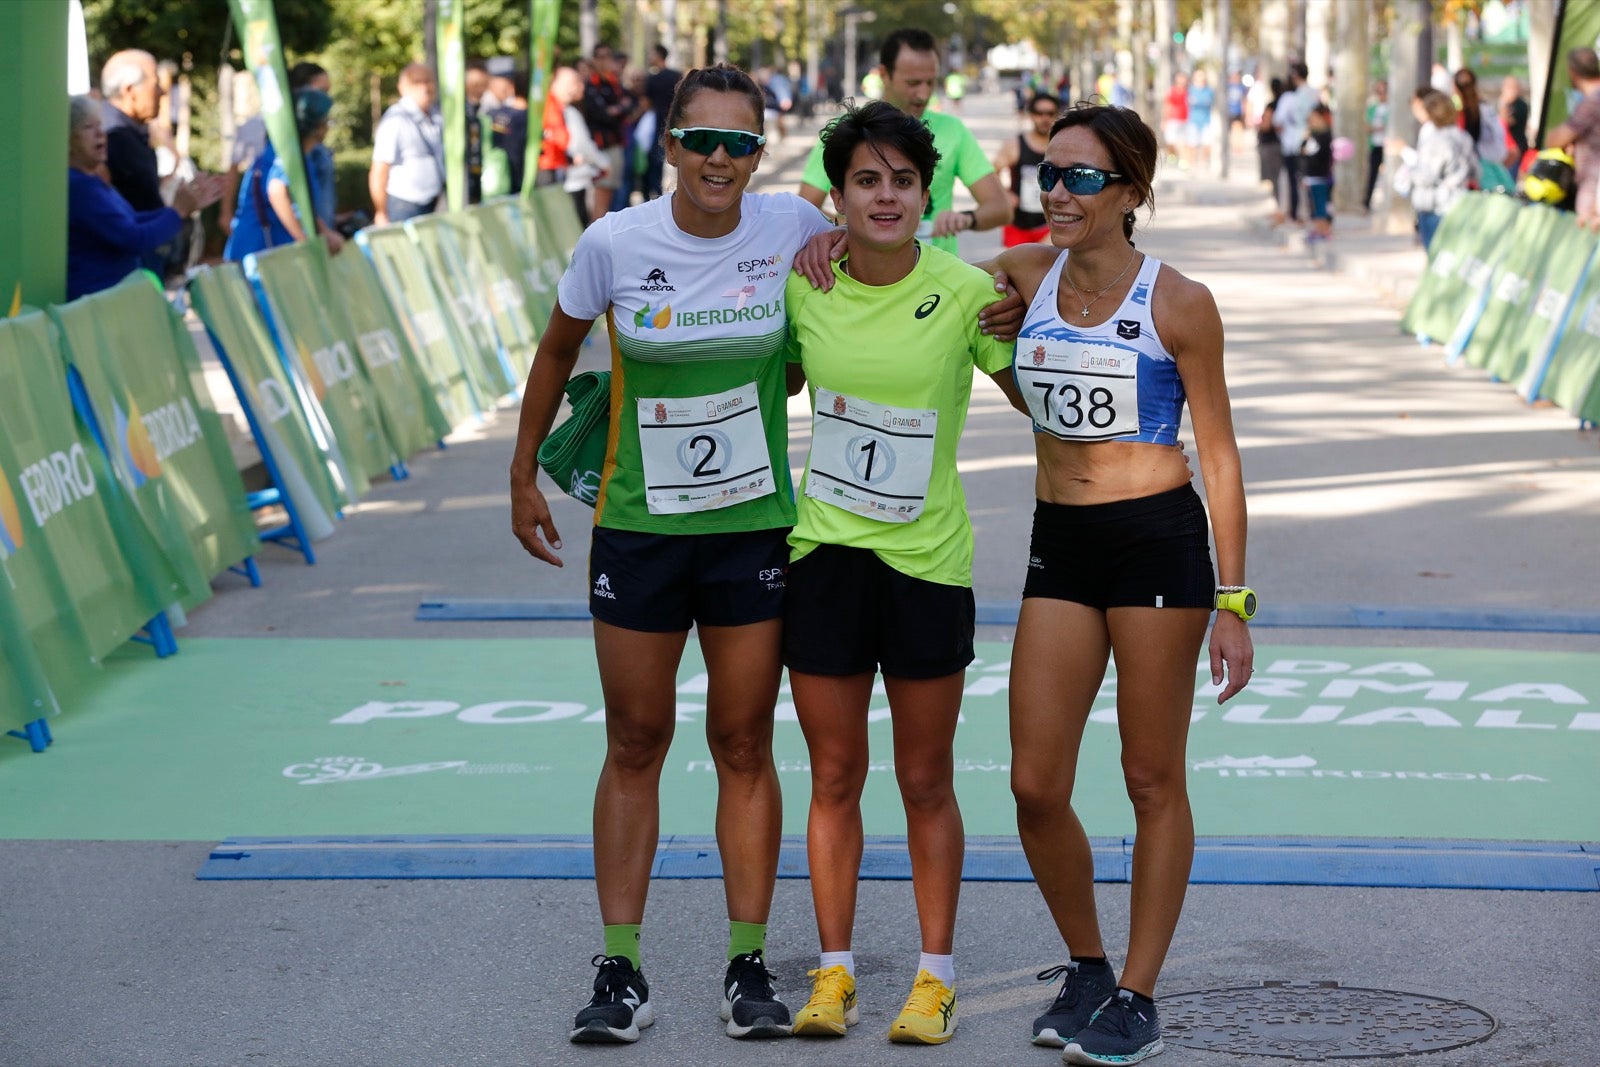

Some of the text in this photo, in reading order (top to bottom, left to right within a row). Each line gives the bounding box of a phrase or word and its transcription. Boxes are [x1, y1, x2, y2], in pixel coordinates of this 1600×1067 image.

[737, 254, 783, 273] ESPAÑA
[746, 270, 779, 283] TRIATÓN
[676, 300, 781, 327] IBERDROLA
[1032, 381, 1117, 429] 738
[689, 434, 721, 478] 2
[860, 439, 877, 482] 1
[281, 762, 384, 779] CSD
[1217, 769, 1551, 783] IBERDROLA
